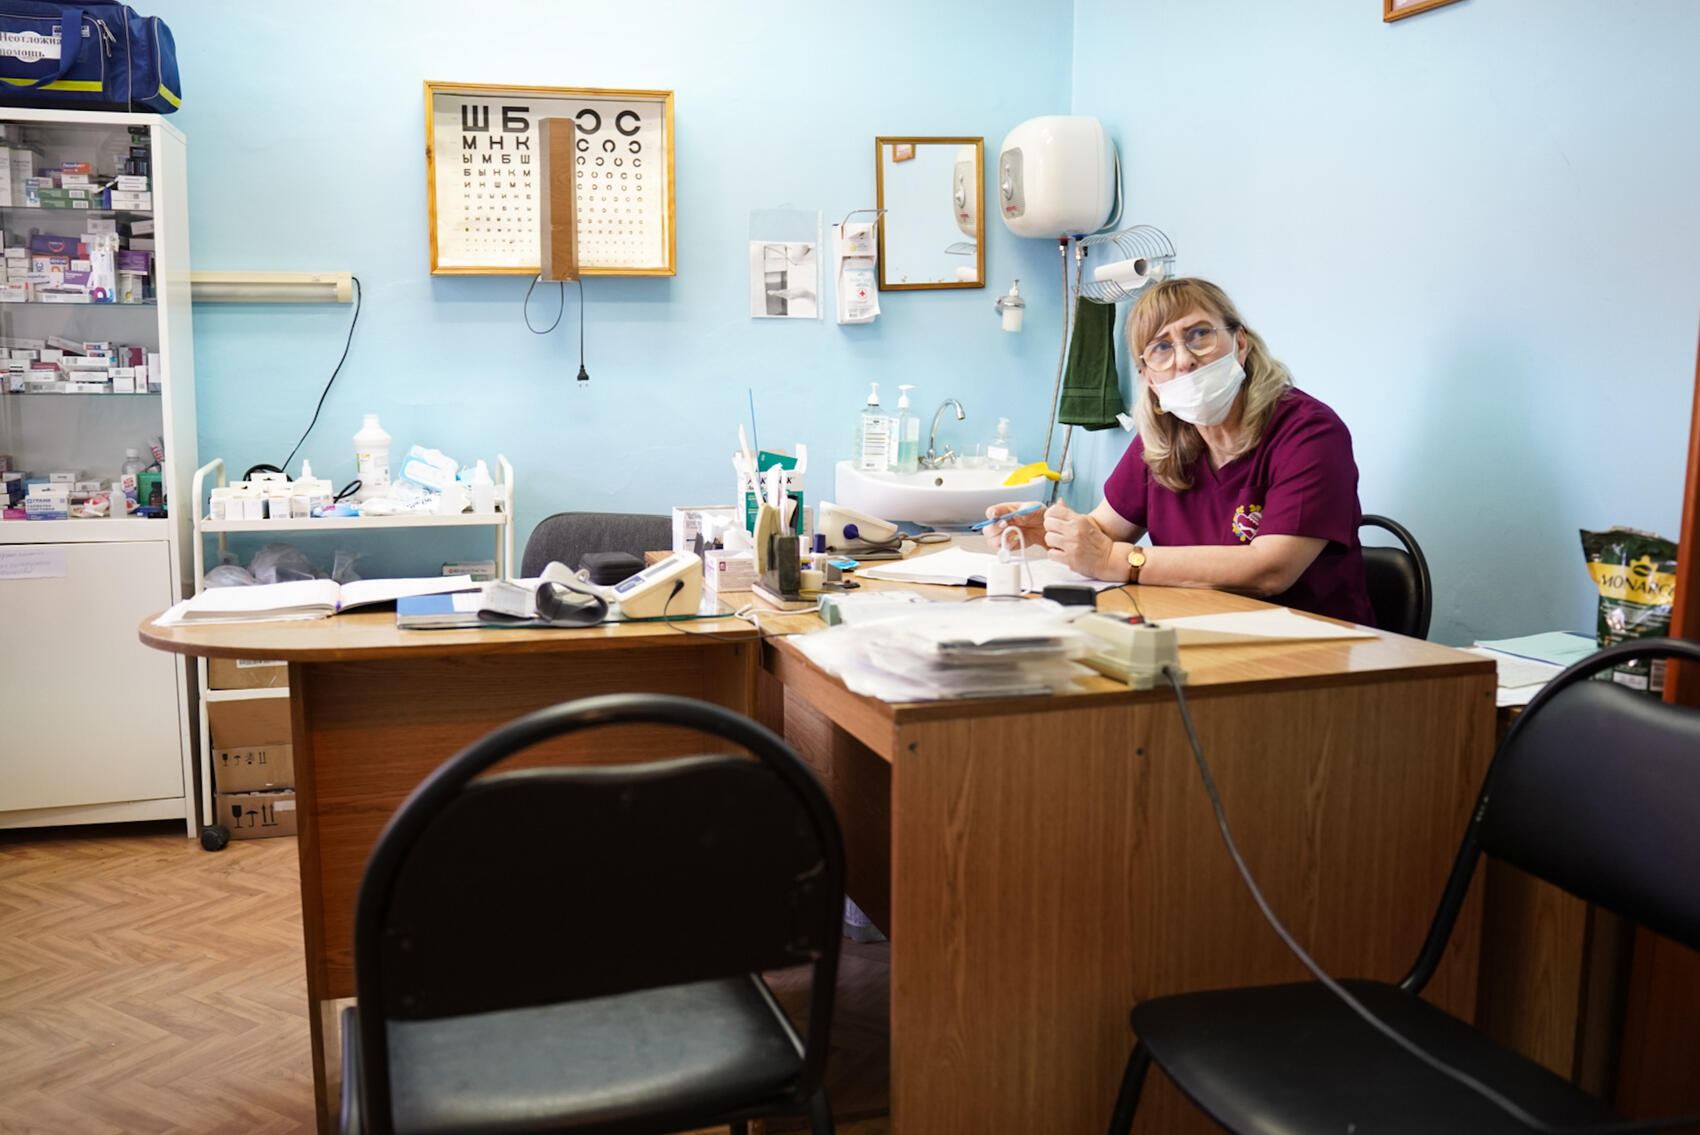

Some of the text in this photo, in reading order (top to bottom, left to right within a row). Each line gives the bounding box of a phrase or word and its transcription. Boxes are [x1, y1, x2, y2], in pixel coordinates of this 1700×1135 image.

[0, 32, 61, 45] Неотложна
[461, 104, 530, 133] Ш Б
[462, 135, 530, 150] М Н К
[463, 154, 530, 164] Ы М Б Ш
